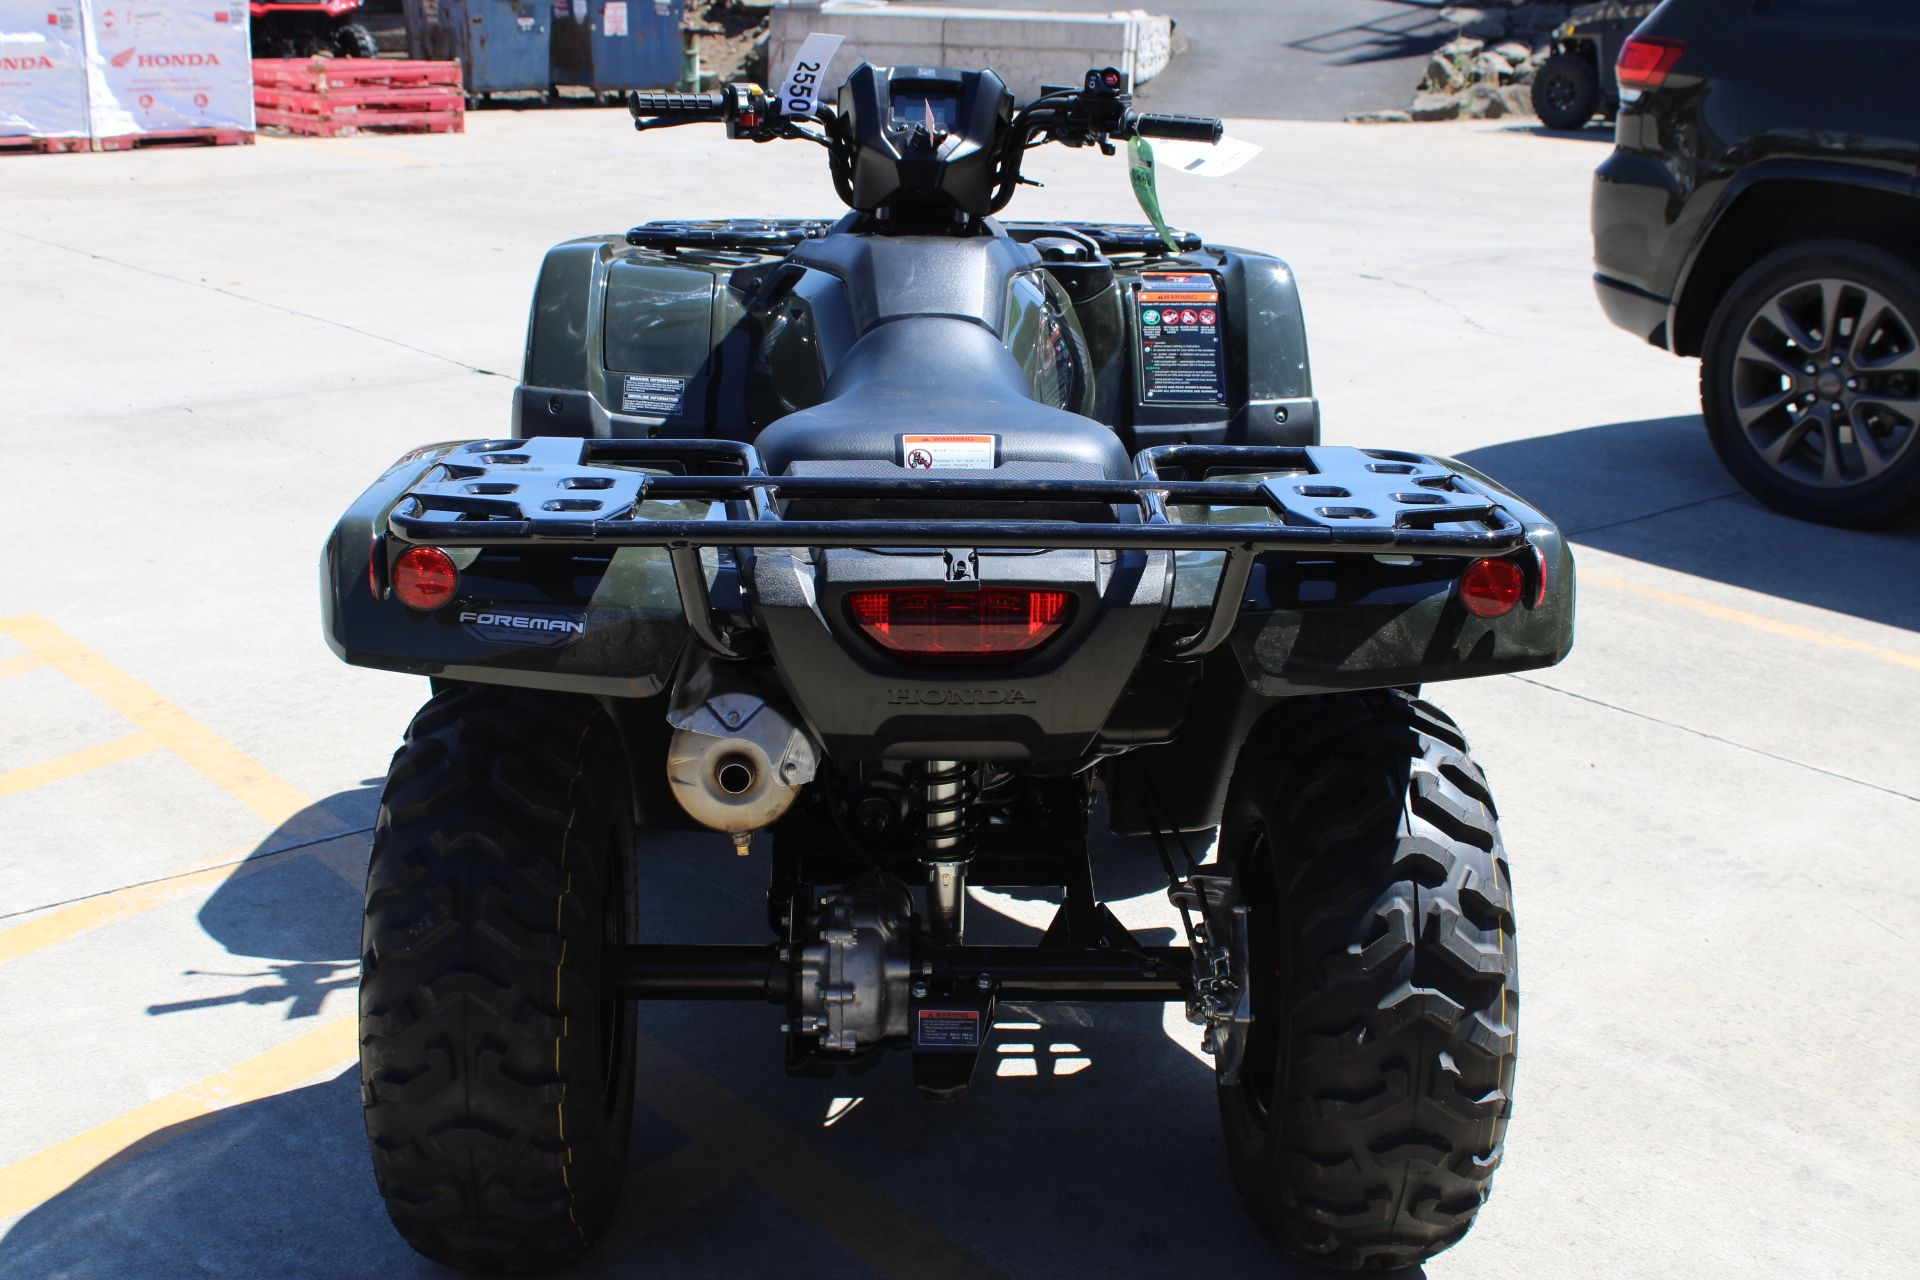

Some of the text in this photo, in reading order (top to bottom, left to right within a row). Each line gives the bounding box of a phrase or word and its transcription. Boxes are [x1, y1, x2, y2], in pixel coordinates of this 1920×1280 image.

[0, 56, 53, 70] NDA
[138, 53, 221, 68] HONDA
[789, 61, 820, 113] 2550
[460, 612, 583, 633] FOREMAN
[887, 689, 1036, 705] HONDA
